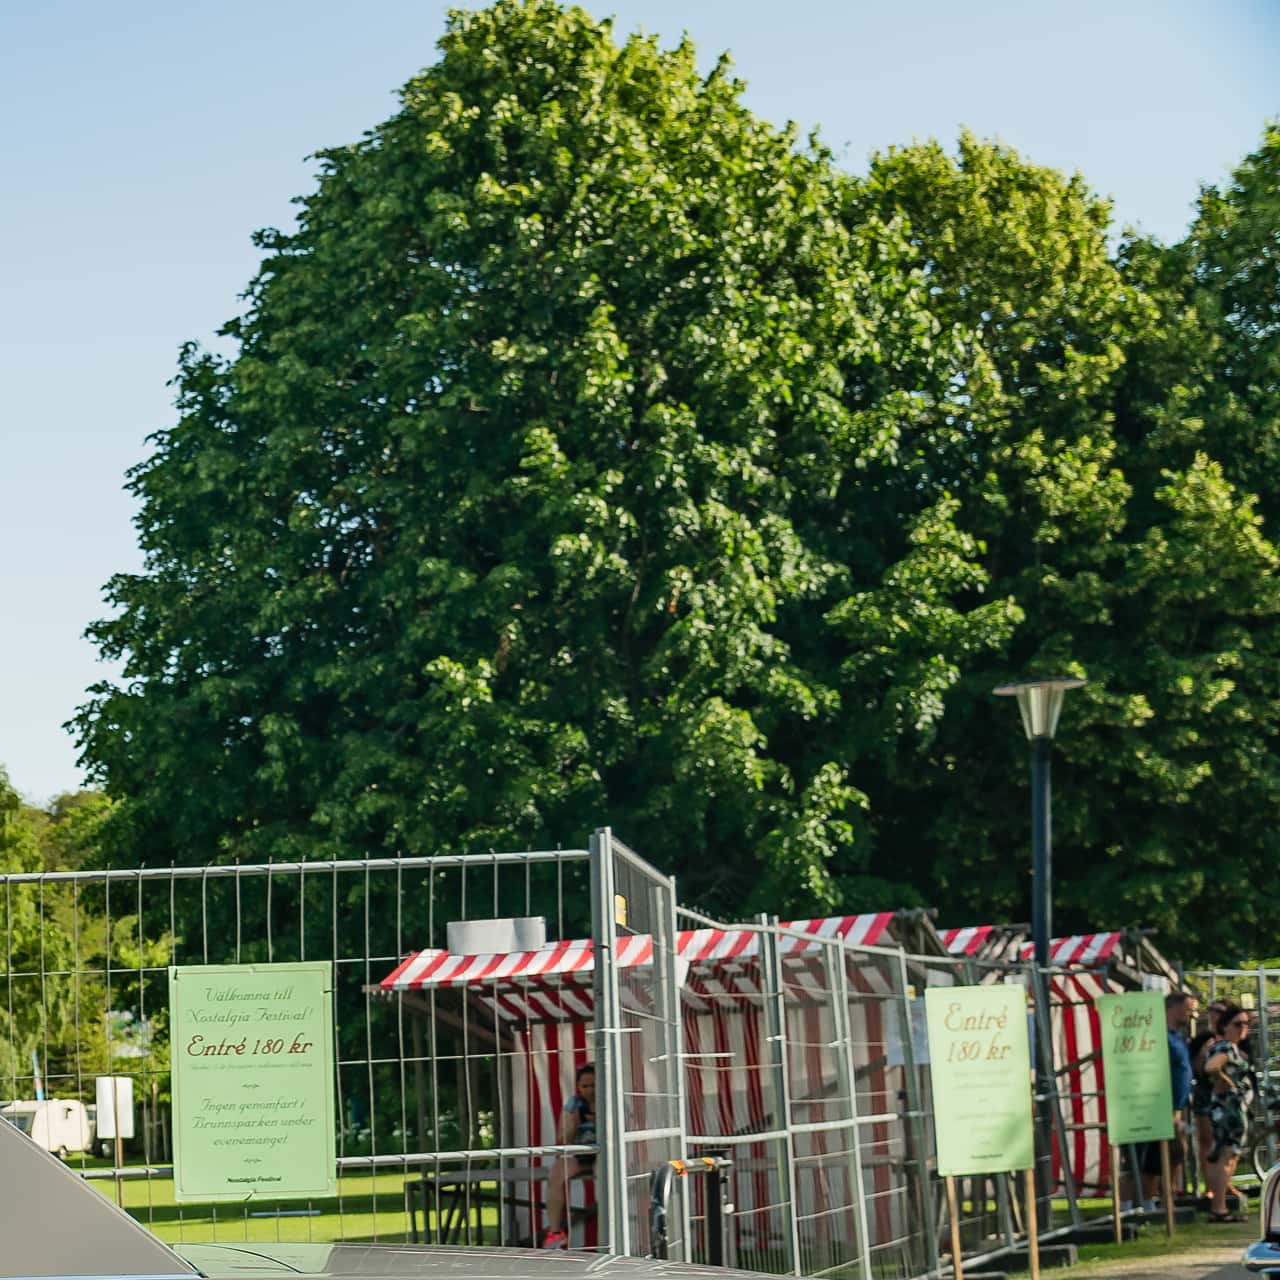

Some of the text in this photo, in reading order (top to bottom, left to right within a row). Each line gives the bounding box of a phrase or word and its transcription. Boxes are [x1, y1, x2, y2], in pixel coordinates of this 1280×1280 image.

[204, 986, 293, 1002] Välkomna till
[187, 1008, 250, 1027] Nostalgia
[944, 1002, 1009, 1032] Entré
[1111, 1004, 1153, 1029] Entré
[187, 1032, 313, 1057] Entré 180 kr
[946, 1032, 1012, 1063] 180 kr
[1113, 1031, 1157, 1055] 180 kr
[201, 1098, 237, 1114] Ingen
[239, 1096, 297, 1113] genomfart
[192, 1114, 316, 1130] Brunnsparken under
